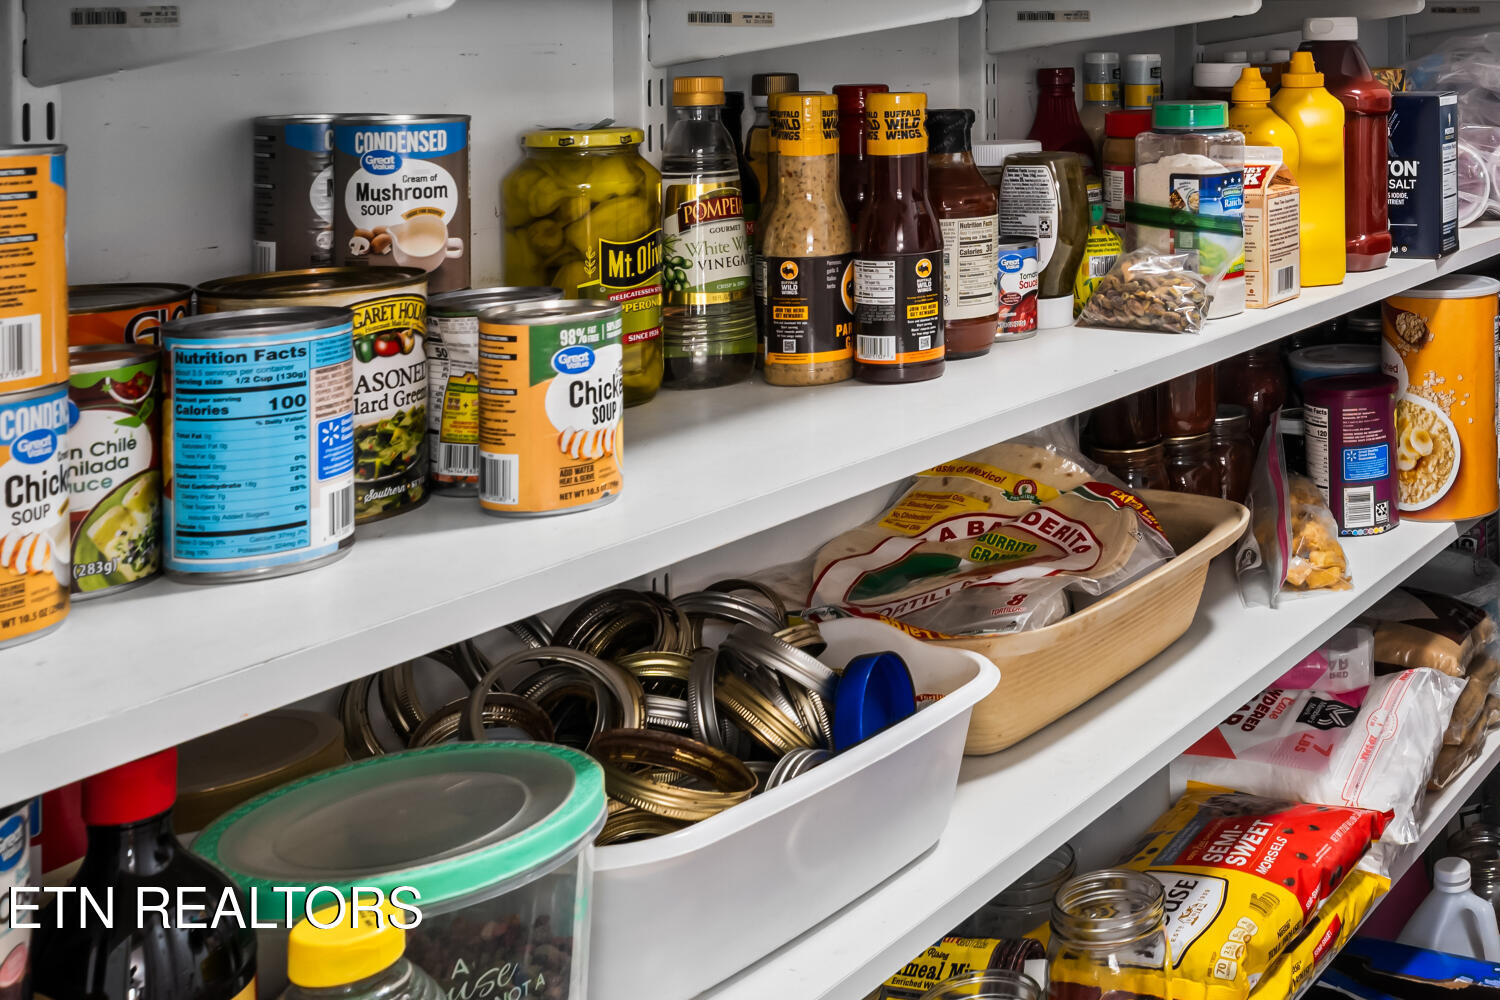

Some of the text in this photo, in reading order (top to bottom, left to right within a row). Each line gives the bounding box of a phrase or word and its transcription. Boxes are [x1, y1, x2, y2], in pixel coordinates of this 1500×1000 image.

[884, 109, 921, 119] BUFFALO
[885, 117, 921, 130] WILD
[354, 129, 448, 154] CONDENSED
[365, 154, 395, 166] Great
[402, 173, 438, 183] Cream of
[1389, 179, 1417, 189] SALT
[356, 182, 449, 202] Mushroom
[361, 204, 393, 216] SOUP
[709, 225, 741, 234] GOURMET
[959, 221, 981, 230] Nutrition
[685, 239, 730, 257] White
[959, 247, 984, 256] Calories
[608, 248, 635, 279] Mt.
[1000, 257, 1020, 269] Great
[559, 328, 587, 347] 98%
[627, 331, 645, 342] SINCE
[175, 346, 307, 367] Nutrition Facts
[558, 352, 589, 366] Great
[254, 374, 272, 385] Cup
[176, 394, 306, 417] Calories 100
[1313, 407, 1327, 415] Facts
[593, 401, 616, 425] SOUP
[1316, 428, 1327, 437] 120
[16, 436, 52, 454] Great
[89, 436, 137, 458] Chile
[967, 466, 1006, 485] Mexico!
[364, 484, 406, 505] Southern
[574, 489, 584, 498] WT
[11, 503, 51, 527] SOUP
[977, 532, 1038, 554] BURRITO
[73, 557, 119, 579] (283g)
[1007, 593, 1028, 607] 8
[1, 617, 16, 630] WT
[1201, 824, 1243, 863] SEMI-
[1225, 819, 1274, 867] SWEET
[1255, 836, 1288, 875] MORSELS
[927, 948, 950, 960] Rising
[451, 958, 470, 979] A
[1216, 962, 1227, 975] 70
[535, 973, 545, 990] A
[891, 977, 922, 988] Enriched
